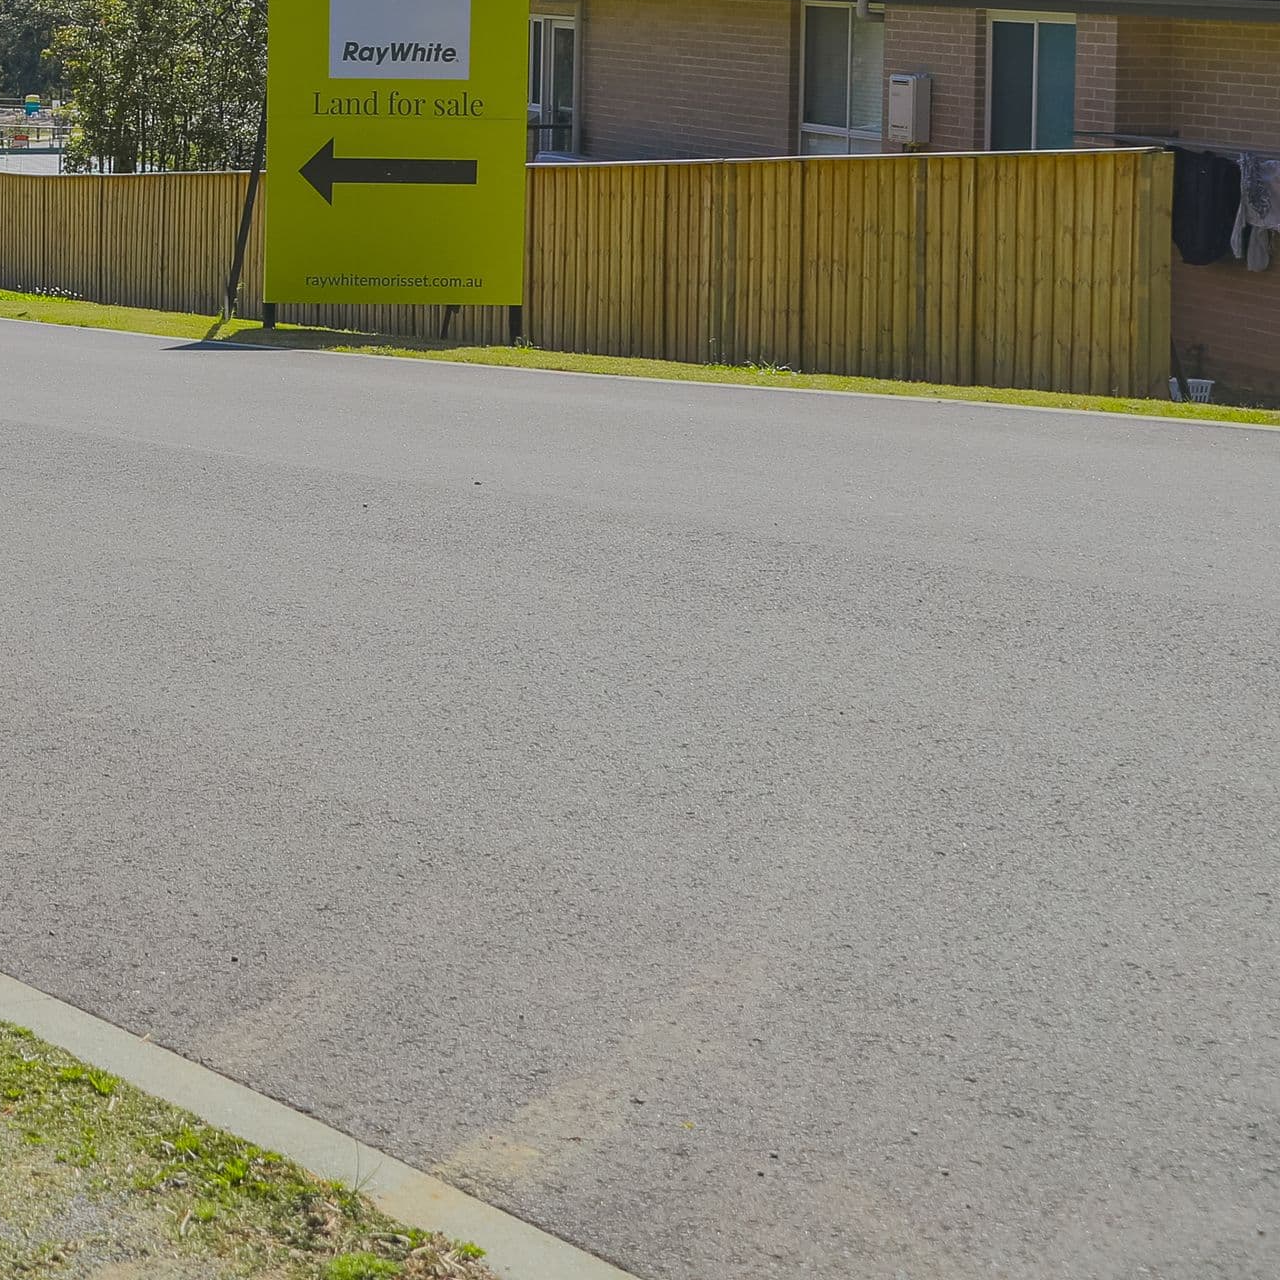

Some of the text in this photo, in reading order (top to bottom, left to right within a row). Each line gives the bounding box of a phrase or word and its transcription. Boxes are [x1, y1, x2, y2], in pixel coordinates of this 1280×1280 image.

[312, 90, 484, 117] Land for sale
[305, 273, 483, 288] raywhitemorisset.com.au
